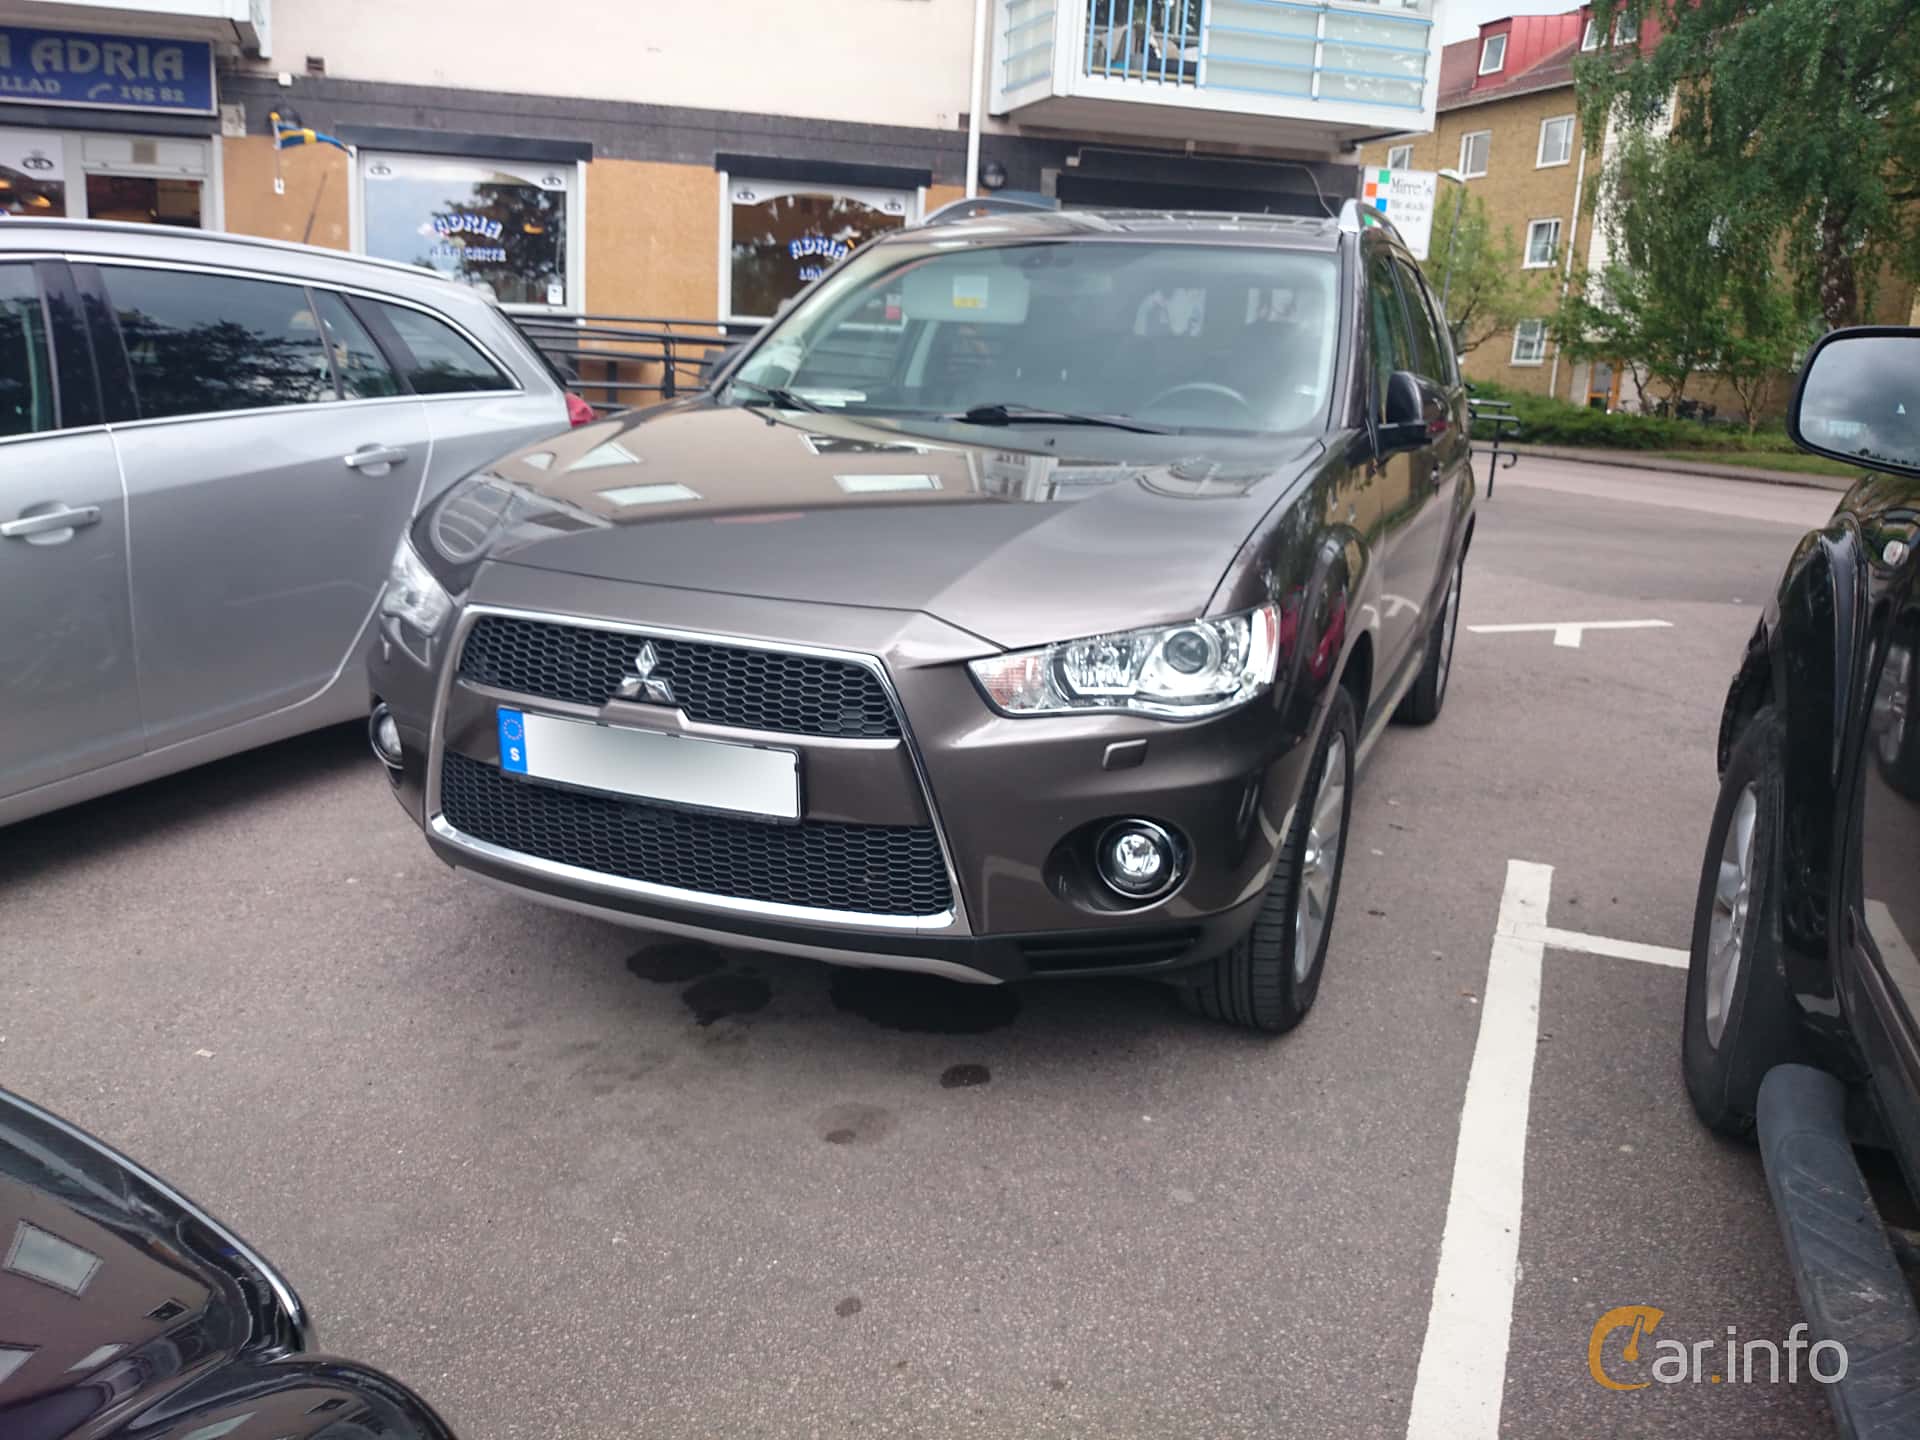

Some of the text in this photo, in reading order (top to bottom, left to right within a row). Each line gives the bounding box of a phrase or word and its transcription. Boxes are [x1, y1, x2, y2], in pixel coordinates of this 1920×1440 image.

[31, 37, 184, 81] ADRIA
[434, 213, 503, 240] ADRIA
[788, 235, 849, 261] ADRIA
[510, 747, 520, 762] S
